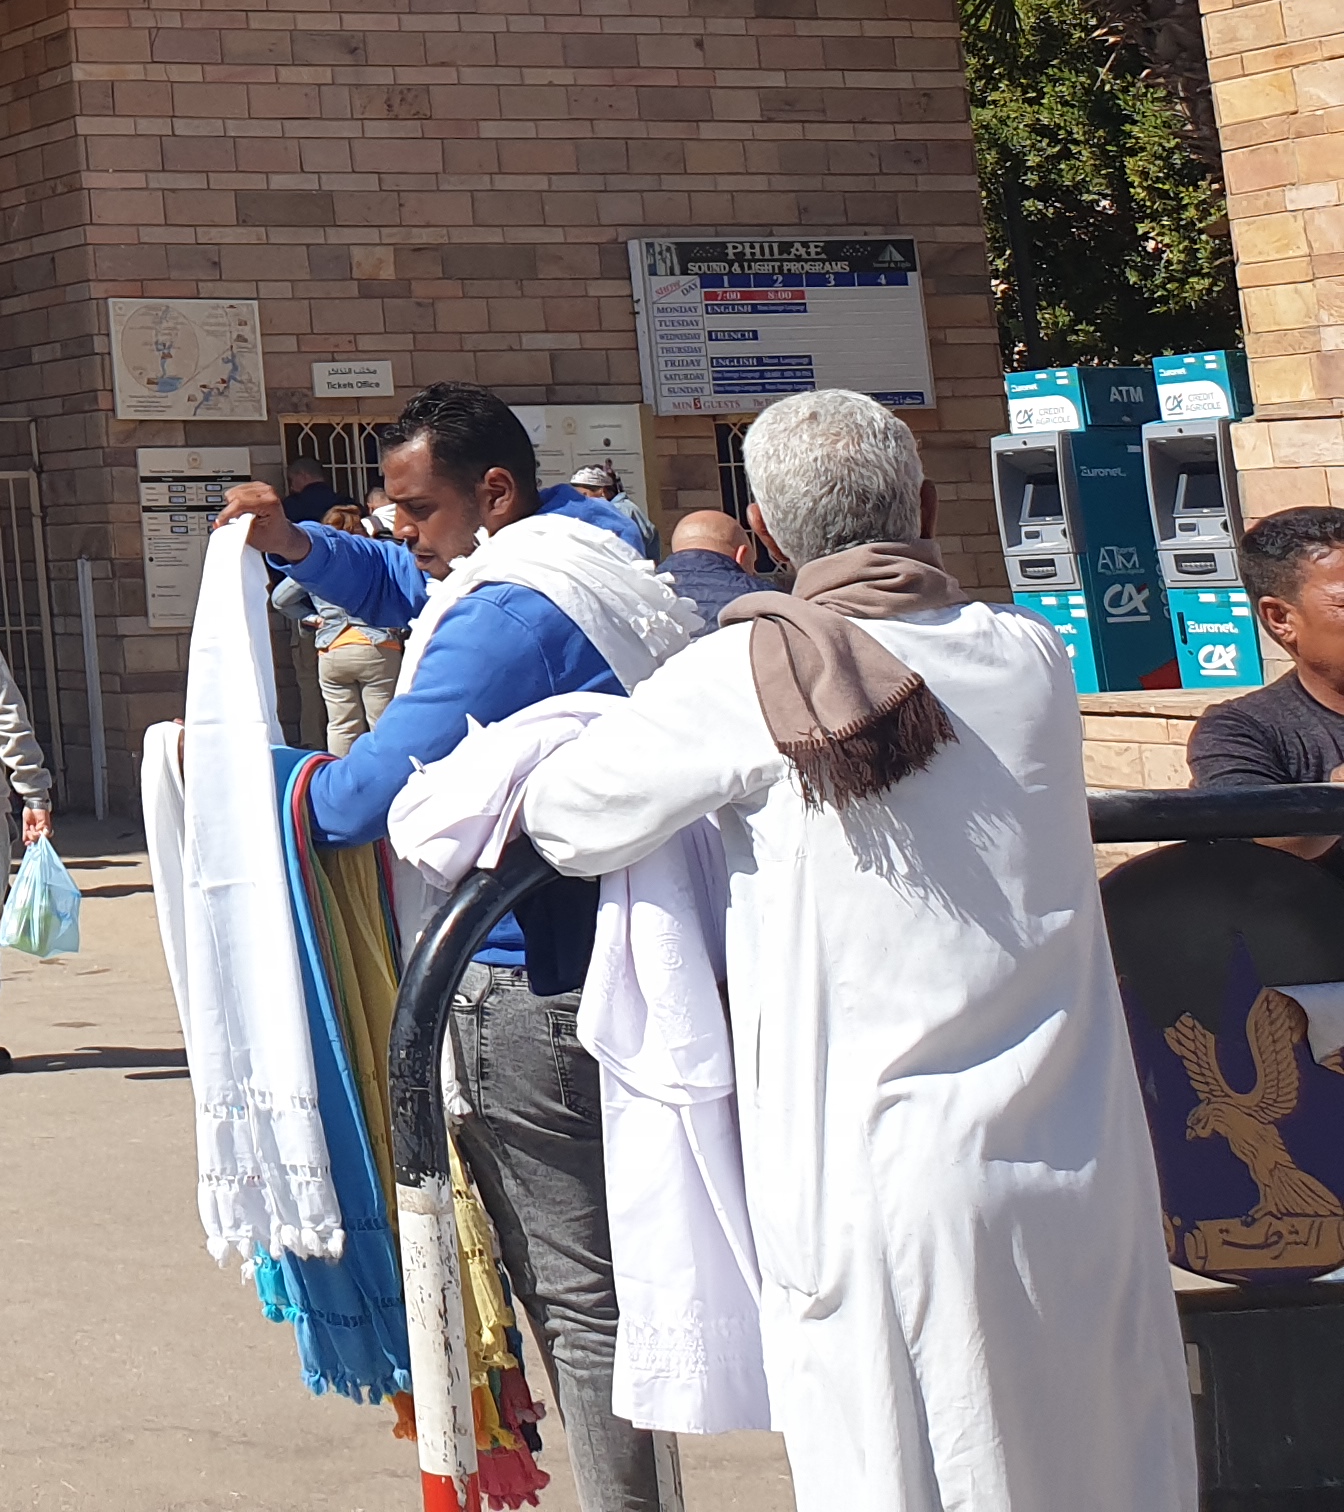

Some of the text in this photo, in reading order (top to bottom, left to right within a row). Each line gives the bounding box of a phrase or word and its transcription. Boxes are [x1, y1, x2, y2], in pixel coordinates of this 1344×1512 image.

[725, 241, 827, 259] PHILAE
[687, 261, 850, 275] SOUND & LIGHT PROGRAMS
[723, 274, 887, 288] 1 2 3 4
[681, 281, 698, 296] DAY
[717, 291, 792, 301] 7:00 8:00
[657, 305, 699, 314] MONDAY
[708, 304, 752, 314] ENGLISH
[658, 318, 700, 328] TUESDAY
[659, 331, 753, 341] WEDNESDAY FRENCH
[660, 345, 703, 354] THURSDAY
[664, 358, 701, 368] FRIDAY
[713, 357, 758, 367] ENGLISH
[664, 372, 705, 382] SATURDAY
[326, 380, 381, 390] Tickets Office
[667, 386, 705, 395] SUNDAY
[1110, 386, 1144, 403] ATM
[672, 400, 692, 410] MIN
[703, 399, 741, 409] GUESTS
[1218, 1219, 1324, 1261] الشرطة
